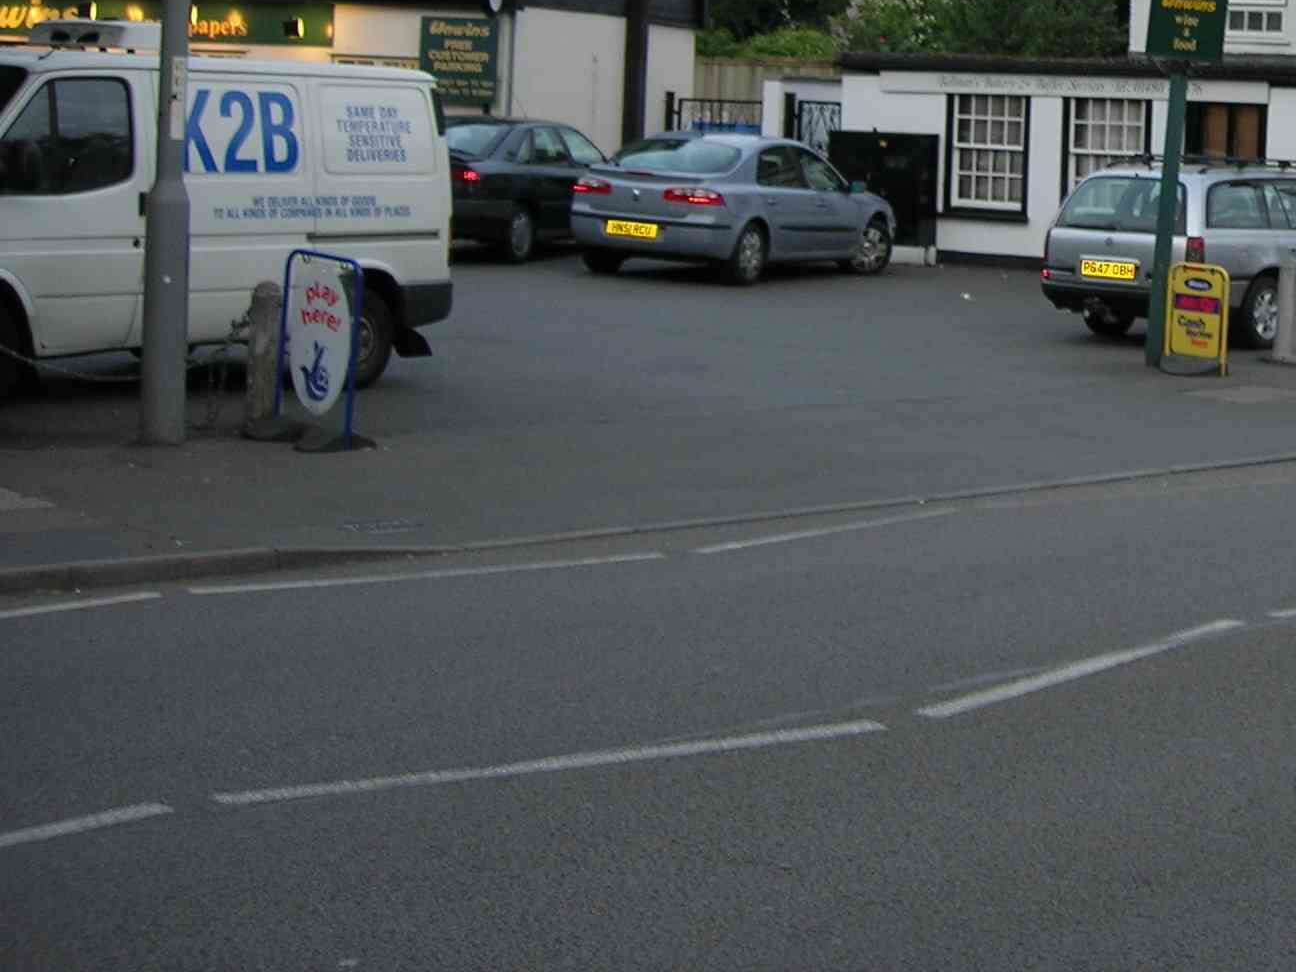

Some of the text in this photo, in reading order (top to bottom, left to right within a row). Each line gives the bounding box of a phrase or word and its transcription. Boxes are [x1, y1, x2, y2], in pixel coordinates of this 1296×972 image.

[1173, 37, 1198, 51] food
[345, 106, 398, 119] SAME DAY
[184, 89, 299, 174] K2B
[336, 119, 412, 134] TEMPERATURE
[349, 134, 403, 149] SENSITIVE
[346, 149, 407, 163] DELIVERIES
[305, 281, 339, 307] play
